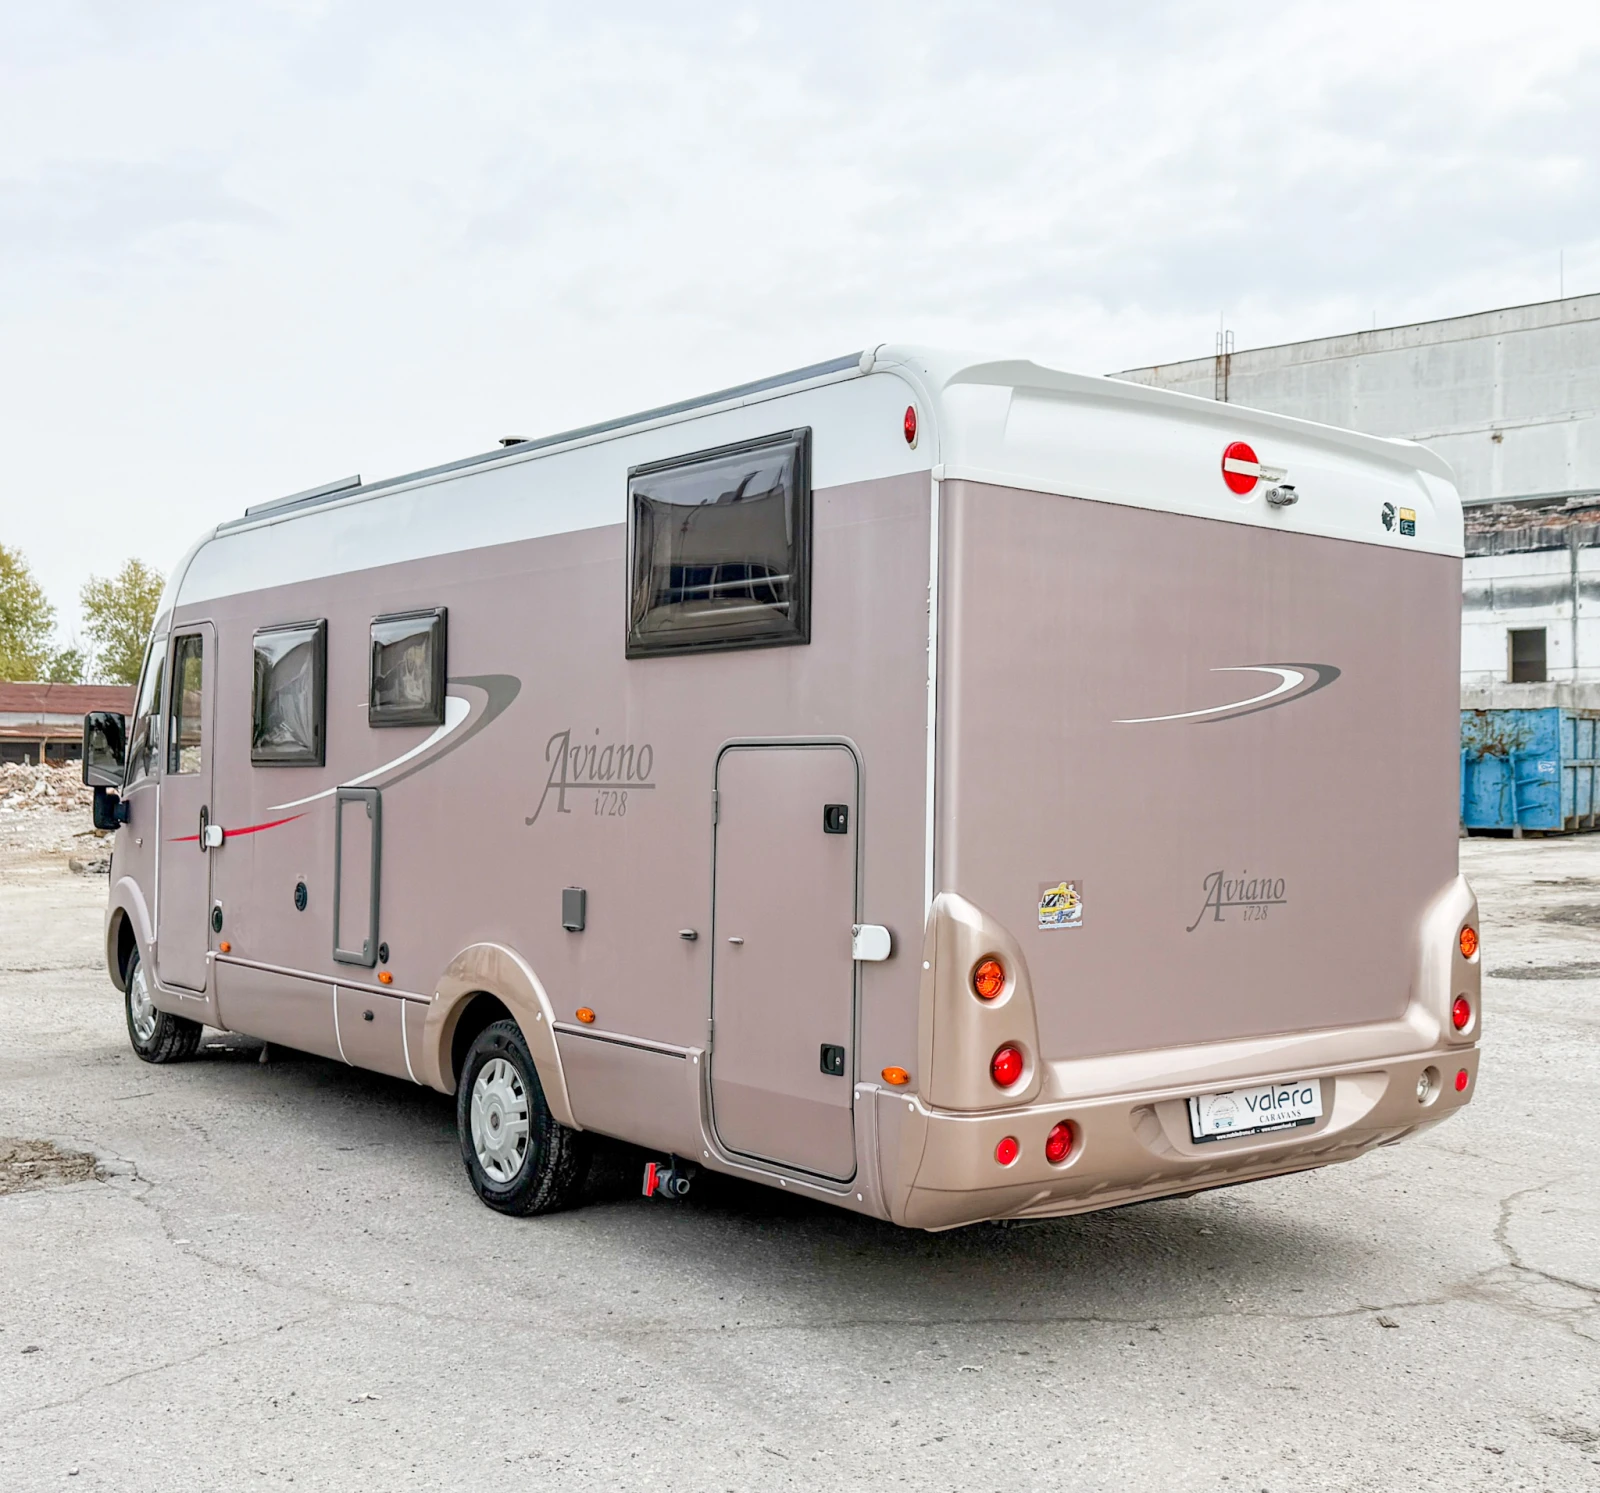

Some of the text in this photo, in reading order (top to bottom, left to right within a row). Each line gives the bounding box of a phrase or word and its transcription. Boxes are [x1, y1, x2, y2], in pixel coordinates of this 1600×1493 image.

[525, 728, 654, 826] Aviano
[594, 790, 629, 817] i728
[1186, 869, 1286, 932] Aviano
[1243, 905, 1269, 921] i728
[1245, 1086, 1313, 1112] valera
[1259, 1109, 1302, 1124] CARAVANS
